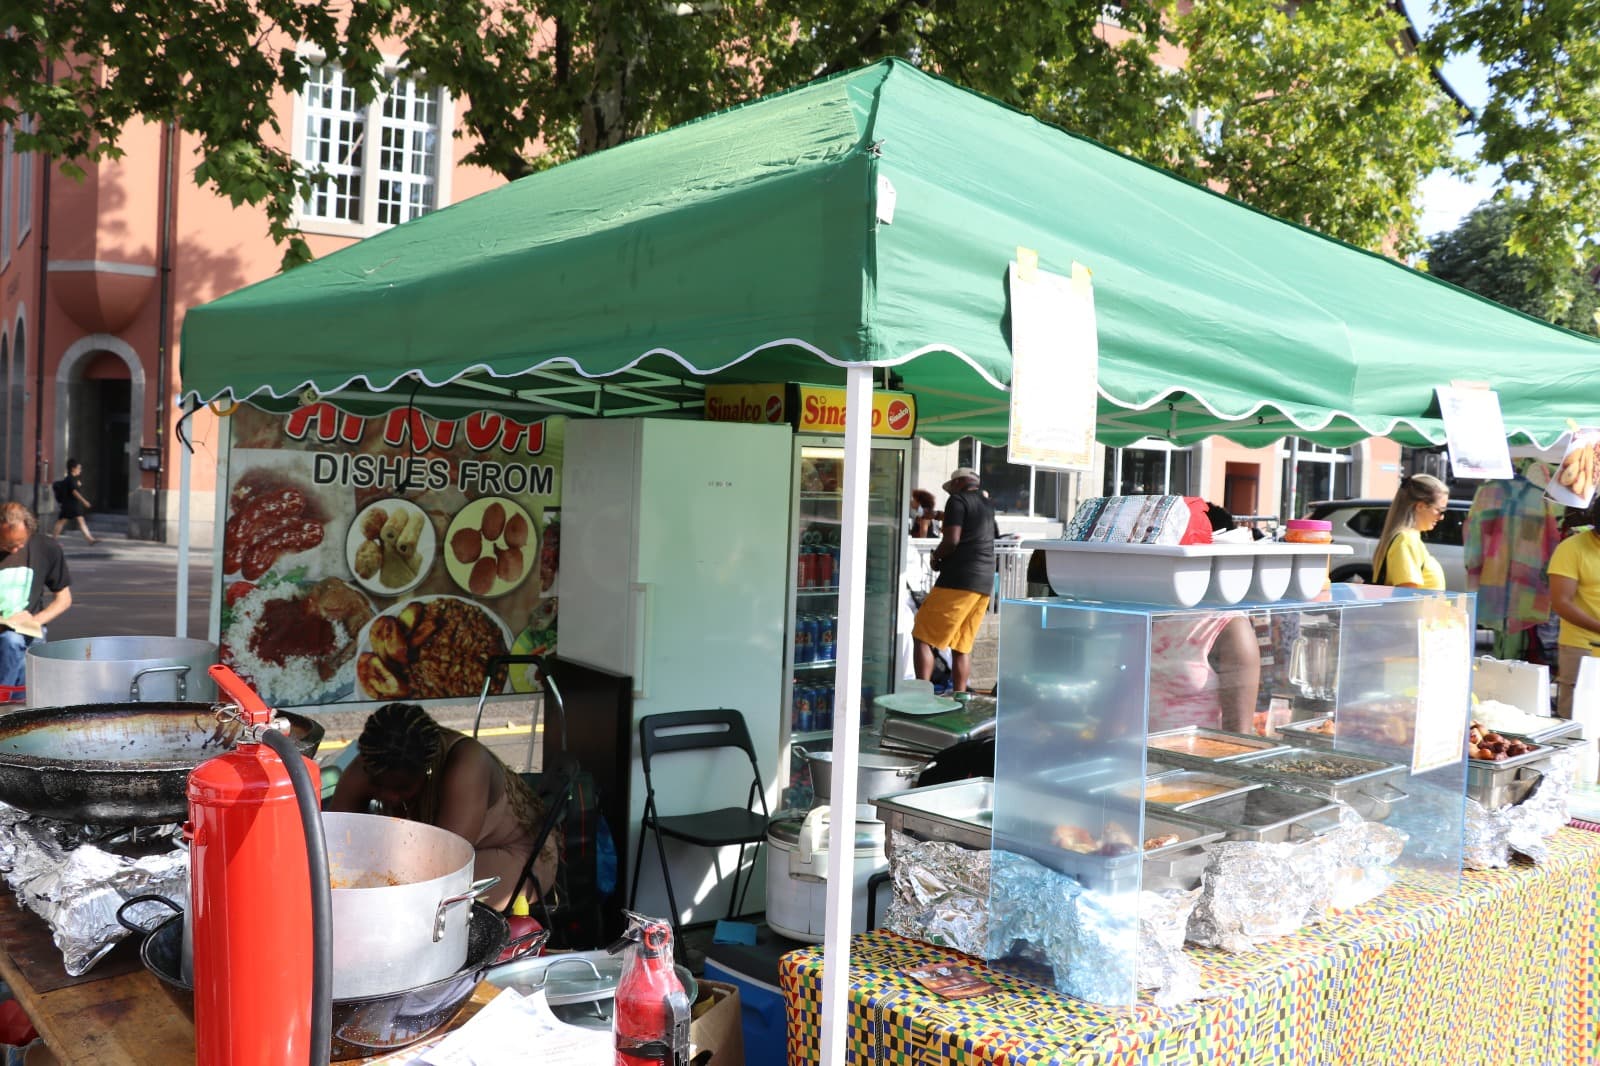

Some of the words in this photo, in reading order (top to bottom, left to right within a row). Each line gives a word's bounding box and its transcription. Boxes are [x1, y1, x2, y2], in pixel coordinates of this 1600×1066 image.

[708, 396, 762, 420] Sinalco
[804, 394, 882, 428] Sinao
[313, 453, 450, 490] DISHES
[458, 460, 554, 494] FROM
